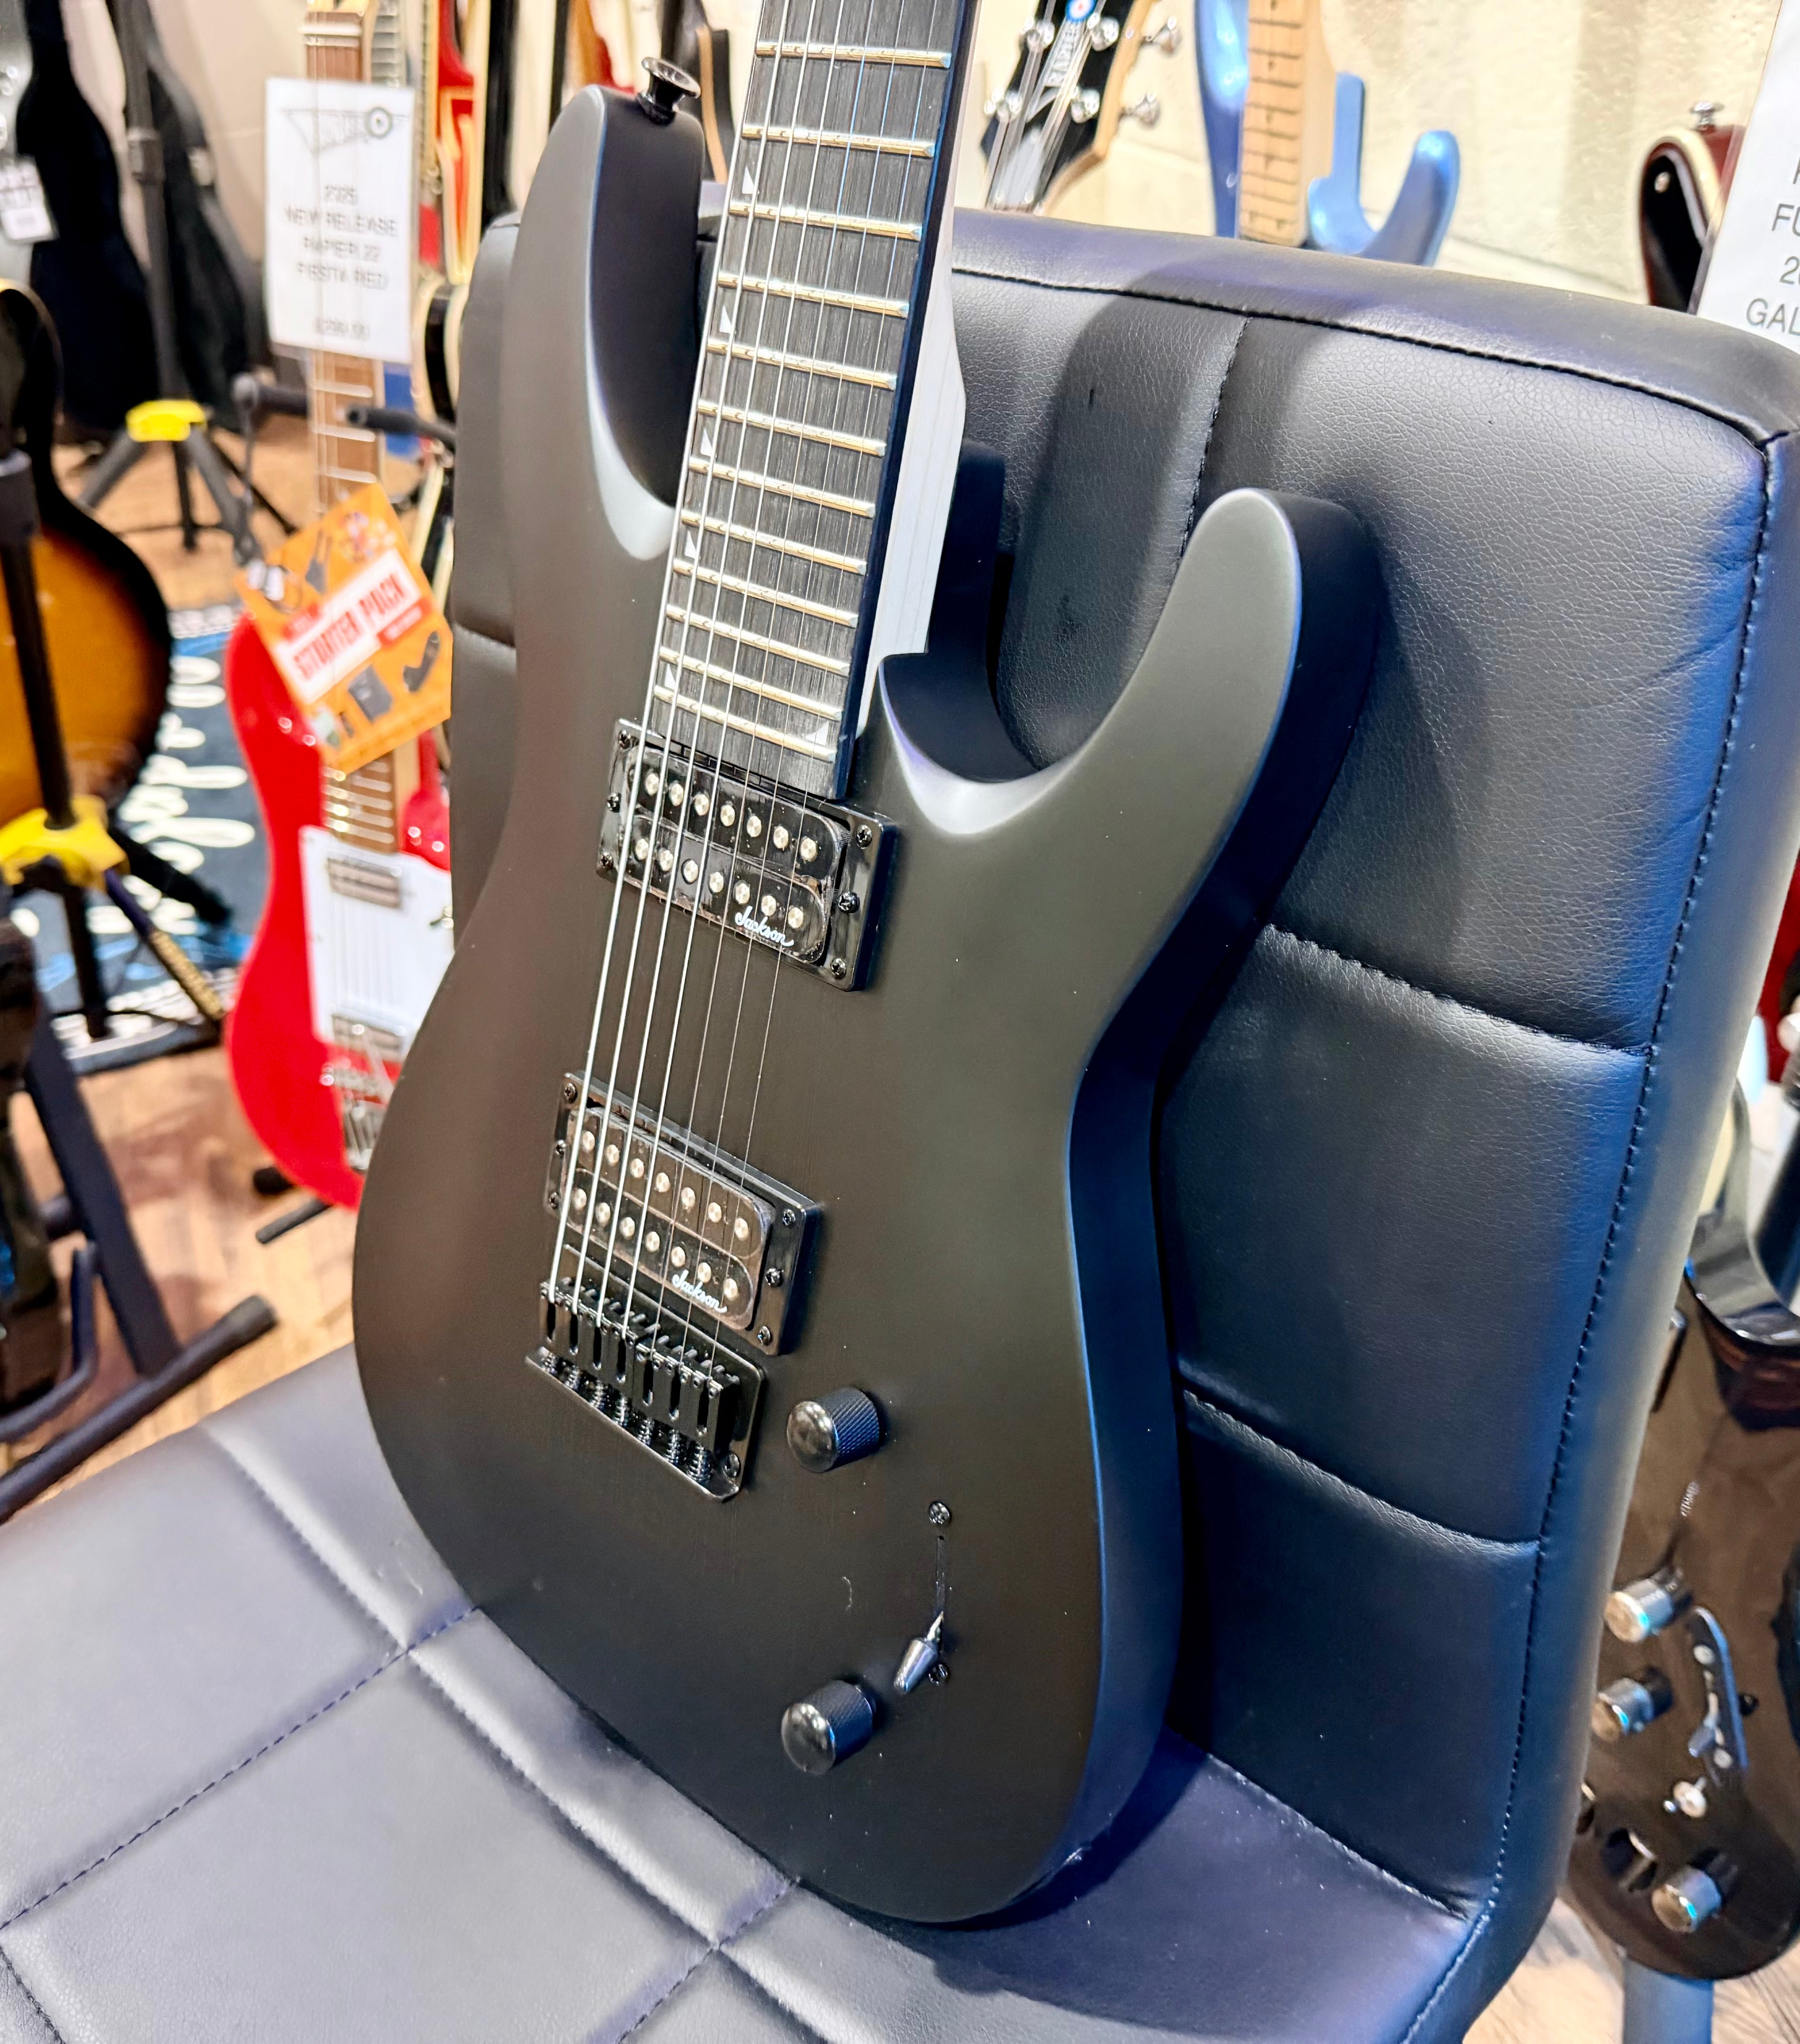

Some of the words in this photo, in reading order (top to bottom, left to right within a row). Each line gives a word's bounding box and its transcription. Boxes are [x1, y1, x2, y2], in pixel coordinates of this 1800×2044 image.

[326, 211, 398, 237] RELEASE
[354, 267, 389, 290] RED
[1779, 255, 1800, 285] 2
[293, 610, 364, 681] STARTER
[358, 572, 409, 626] PACK
[735, 906, 794, 946] Jackson
[672, 1270, 727, 1313] Jackson
